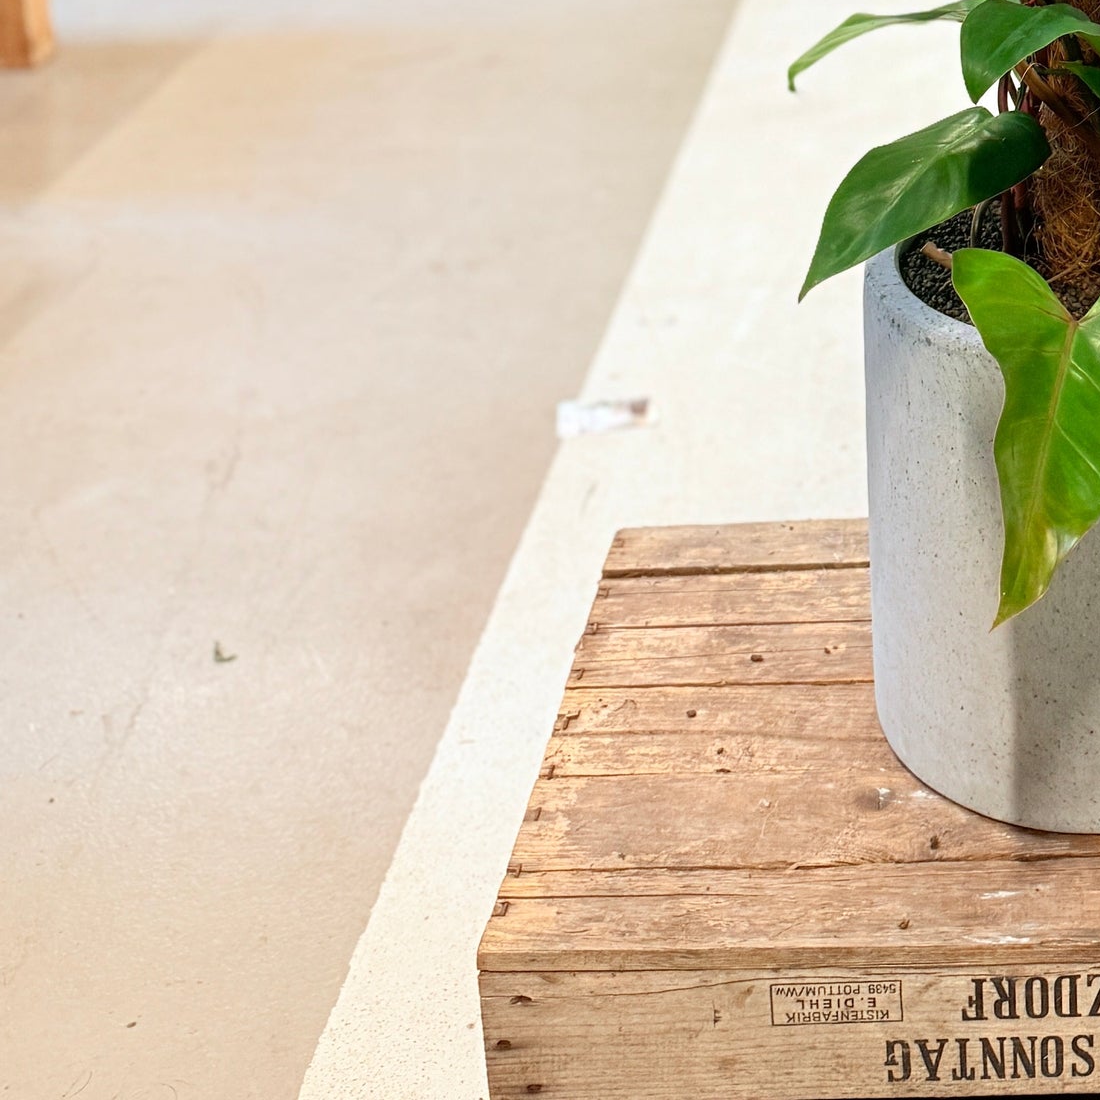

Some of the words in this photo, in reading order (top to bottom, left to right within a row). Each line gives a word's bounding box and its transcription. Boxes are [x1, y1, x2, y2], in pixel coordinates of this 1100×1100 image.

[868, 983, 896, 994] 5439
[796, 998, 855, 1009] DIEHL
[861, 997, 877, 1008] E.
[786, 1009, 889, 1023] KISTENFABRIK
[884, 1034, 1095, 1083] SONNTAG
